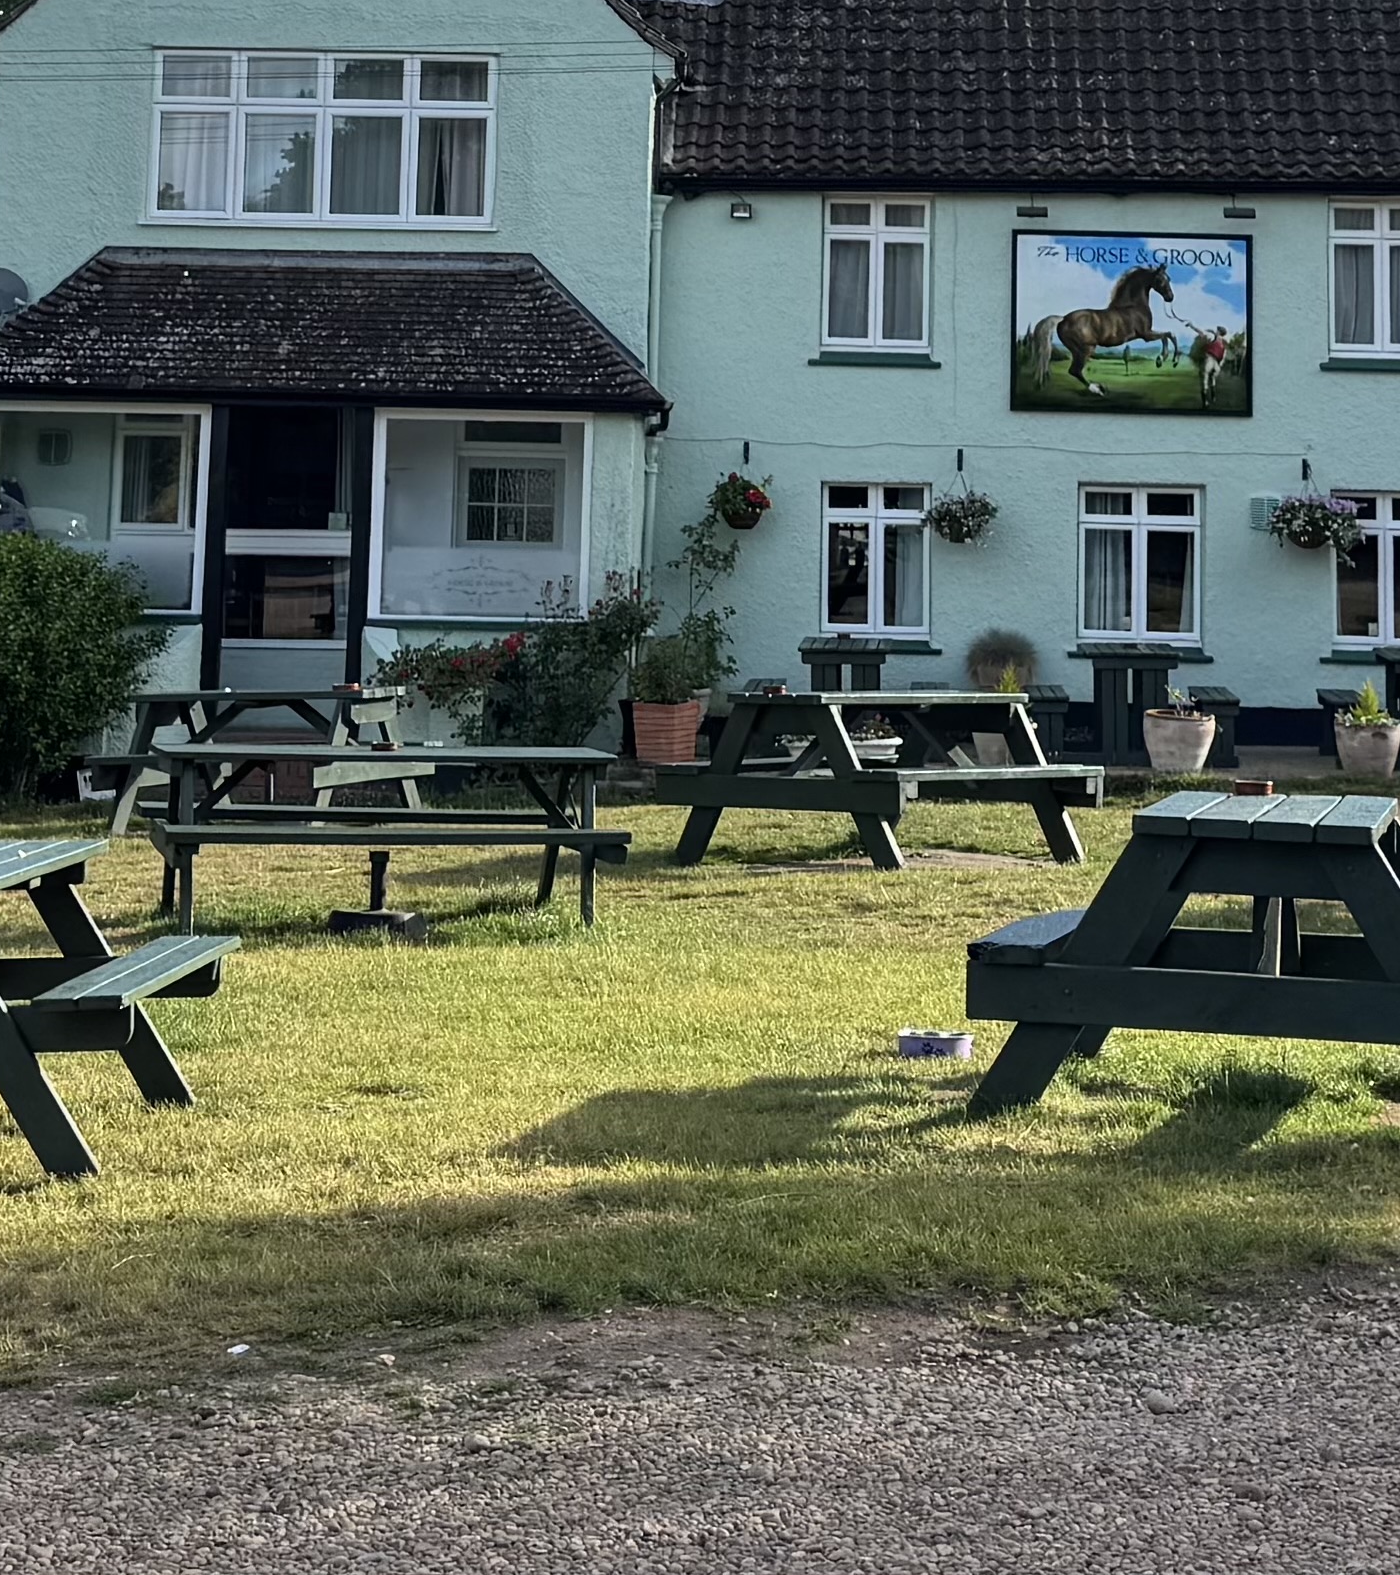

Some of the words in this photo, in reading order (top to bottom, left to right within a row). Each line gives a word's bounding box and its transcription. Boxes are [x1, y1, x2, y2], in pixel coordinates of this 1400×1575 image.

[1037, 245, 1059, 257] The
[1065, 246, 1129, 264] HORSE
[1135, 247, 1149, 264] &
[1152, 248, 1232, 267] GROOM
